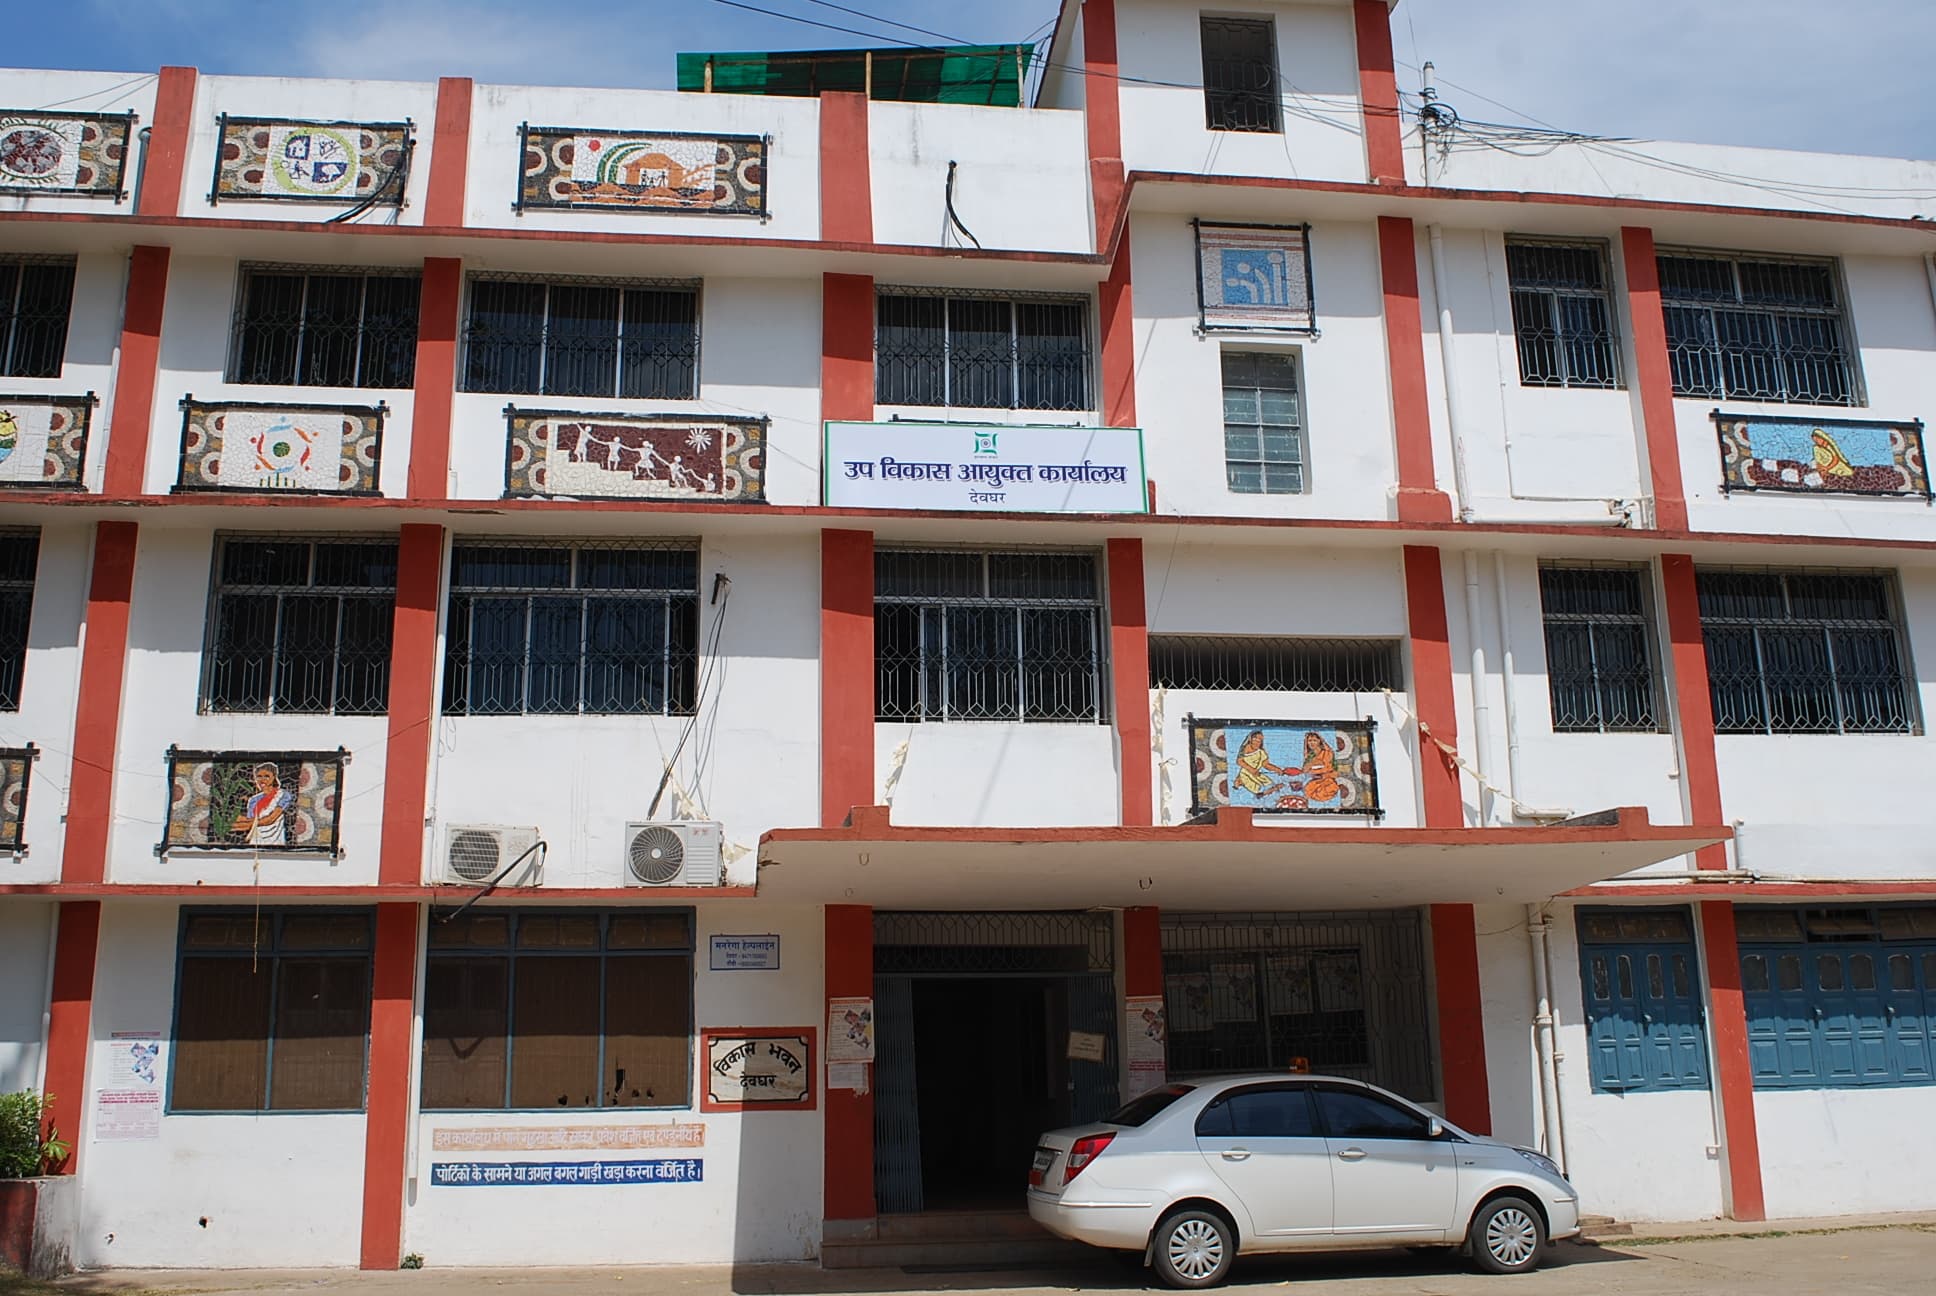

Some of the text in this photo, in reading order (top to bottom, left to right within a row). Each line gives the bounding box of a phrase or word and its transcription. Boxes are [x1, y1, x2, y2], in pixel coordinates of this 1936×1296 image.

[843, 457, 1127, 488] उप विकास आयुक्त कार्यालय
[968, 488, 1006, 504] देवघर
[715, 939, 740, 950] मनरेगा
[713, 1042, 756, 1076] विकास
[768, 1043, 801, 1074] भवन
[740, 1072, 777, 1091] देवघर
[435, 1165, 470, 1182] पोर्टिको
[472, 1164, 482, 1181] के
[484, 1164, 512, 1182] सामने
[514, 1167, 527, 1181] या
[528, 1166, 552, 1182] अगल
[579, 1163, 602, 1183] गाड़ी
[604, 1165, 624, 1182] खड़ा
[625, 1165, 653, 1180] करना
[655, 1161, 685, 1180] वर्जित
